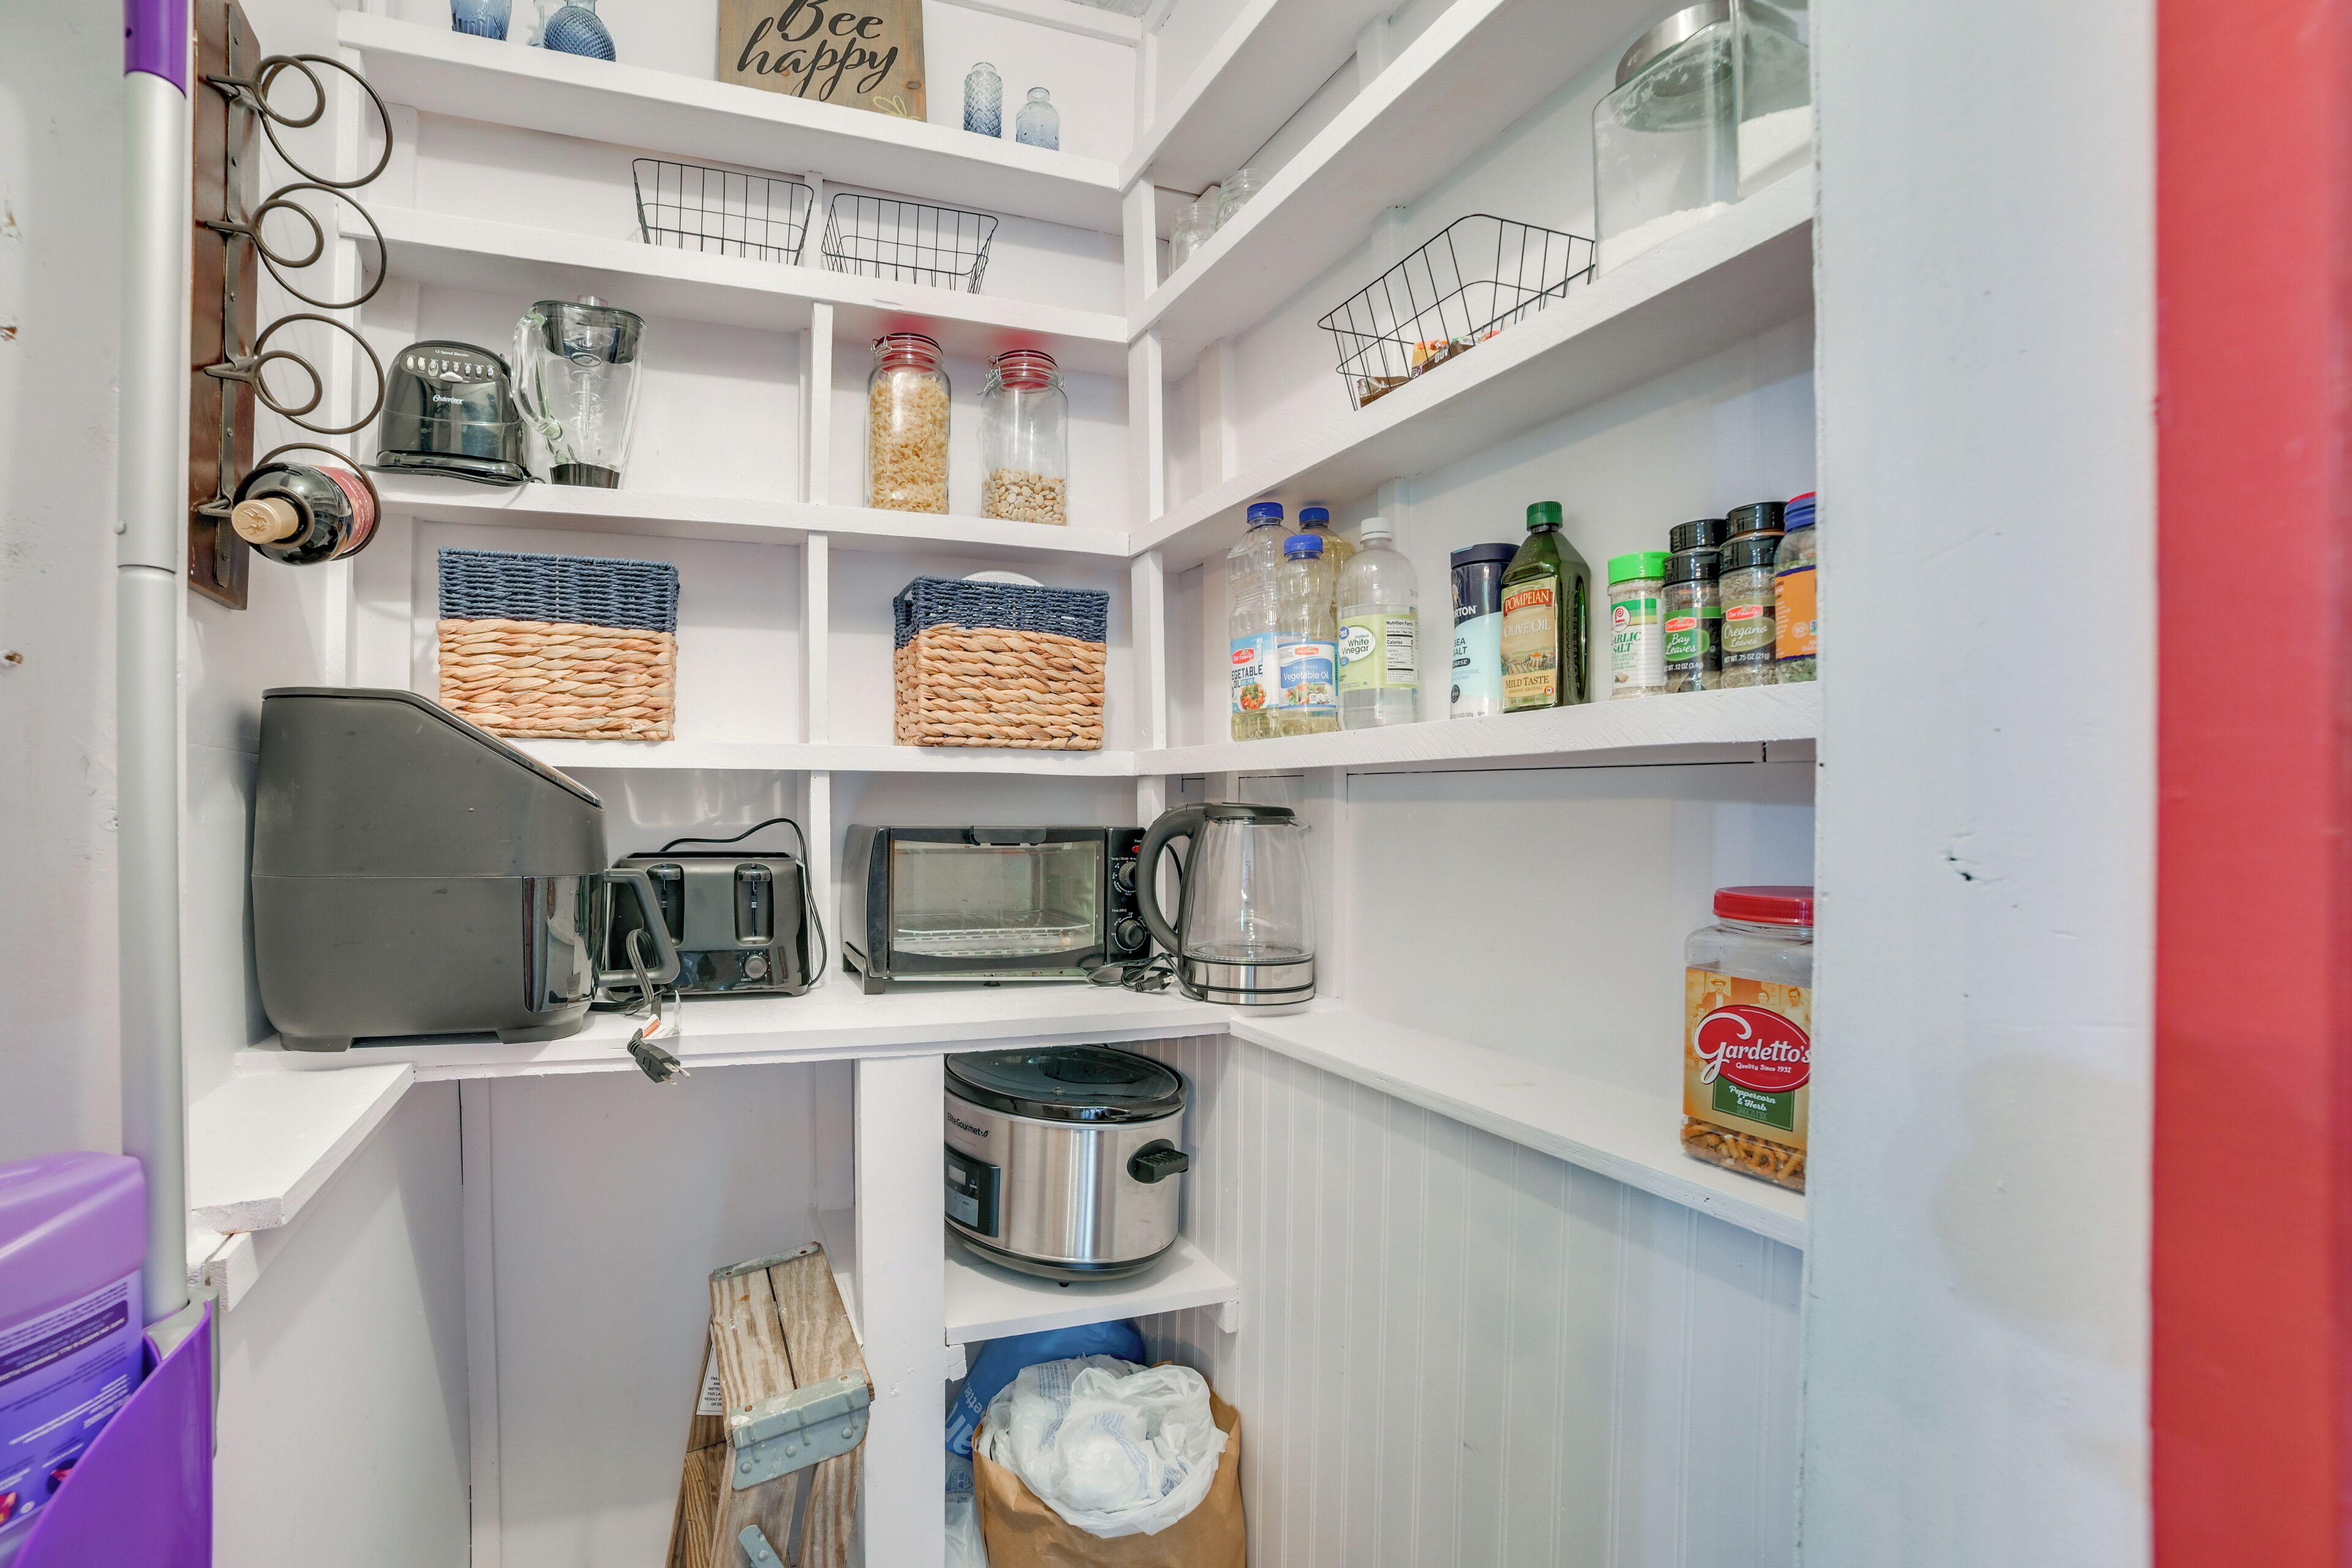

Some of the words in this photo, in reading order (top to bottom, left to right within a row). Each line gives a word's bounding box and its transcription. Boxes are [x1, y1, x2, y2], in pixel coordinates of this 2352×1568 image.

[777, 0, 883, 42] Bee
[737, 17, 899, 102] happy
[432, 394, 464, 403] Osterizer
[1505, 589, 1549, 612] POMPEIAN
[1504, 622, 1529, 638] OLIVE
[1532, 618, 1551, 632] OIL
[1724, 624, 1768, 639] Oregano
[1348, 638, 1369, 647] White
[1454, 637, 1466, 647] SEA
[1672, 633, 1691, 646] Bay
[1730, 637, 1758, 647] Leaves
[1341, 646, 1369, 655] Vinegar
[1453, 646, 1468, 657] SALT
[1612, 643, 1633, 655] SALT
[1666, 643, 1695, 655] Leaves
[1284, 671, 1319, 681] Vegetable
[1506, 678, 1522, 689] MILD
[1523, 675, 1550, 685] TASTE
[1694, 1012, 1811, 1085] Gardetto's
[1736, 1062, 1758, 1071] Quality
[1728, 1085, 1776, 1104] Peppercorn
[1744, 1099, 1767, 1111] Herb
[1736, 1106, 1755, 1117] SNACK
[1756, 1109, 1767, 1121] MIX
